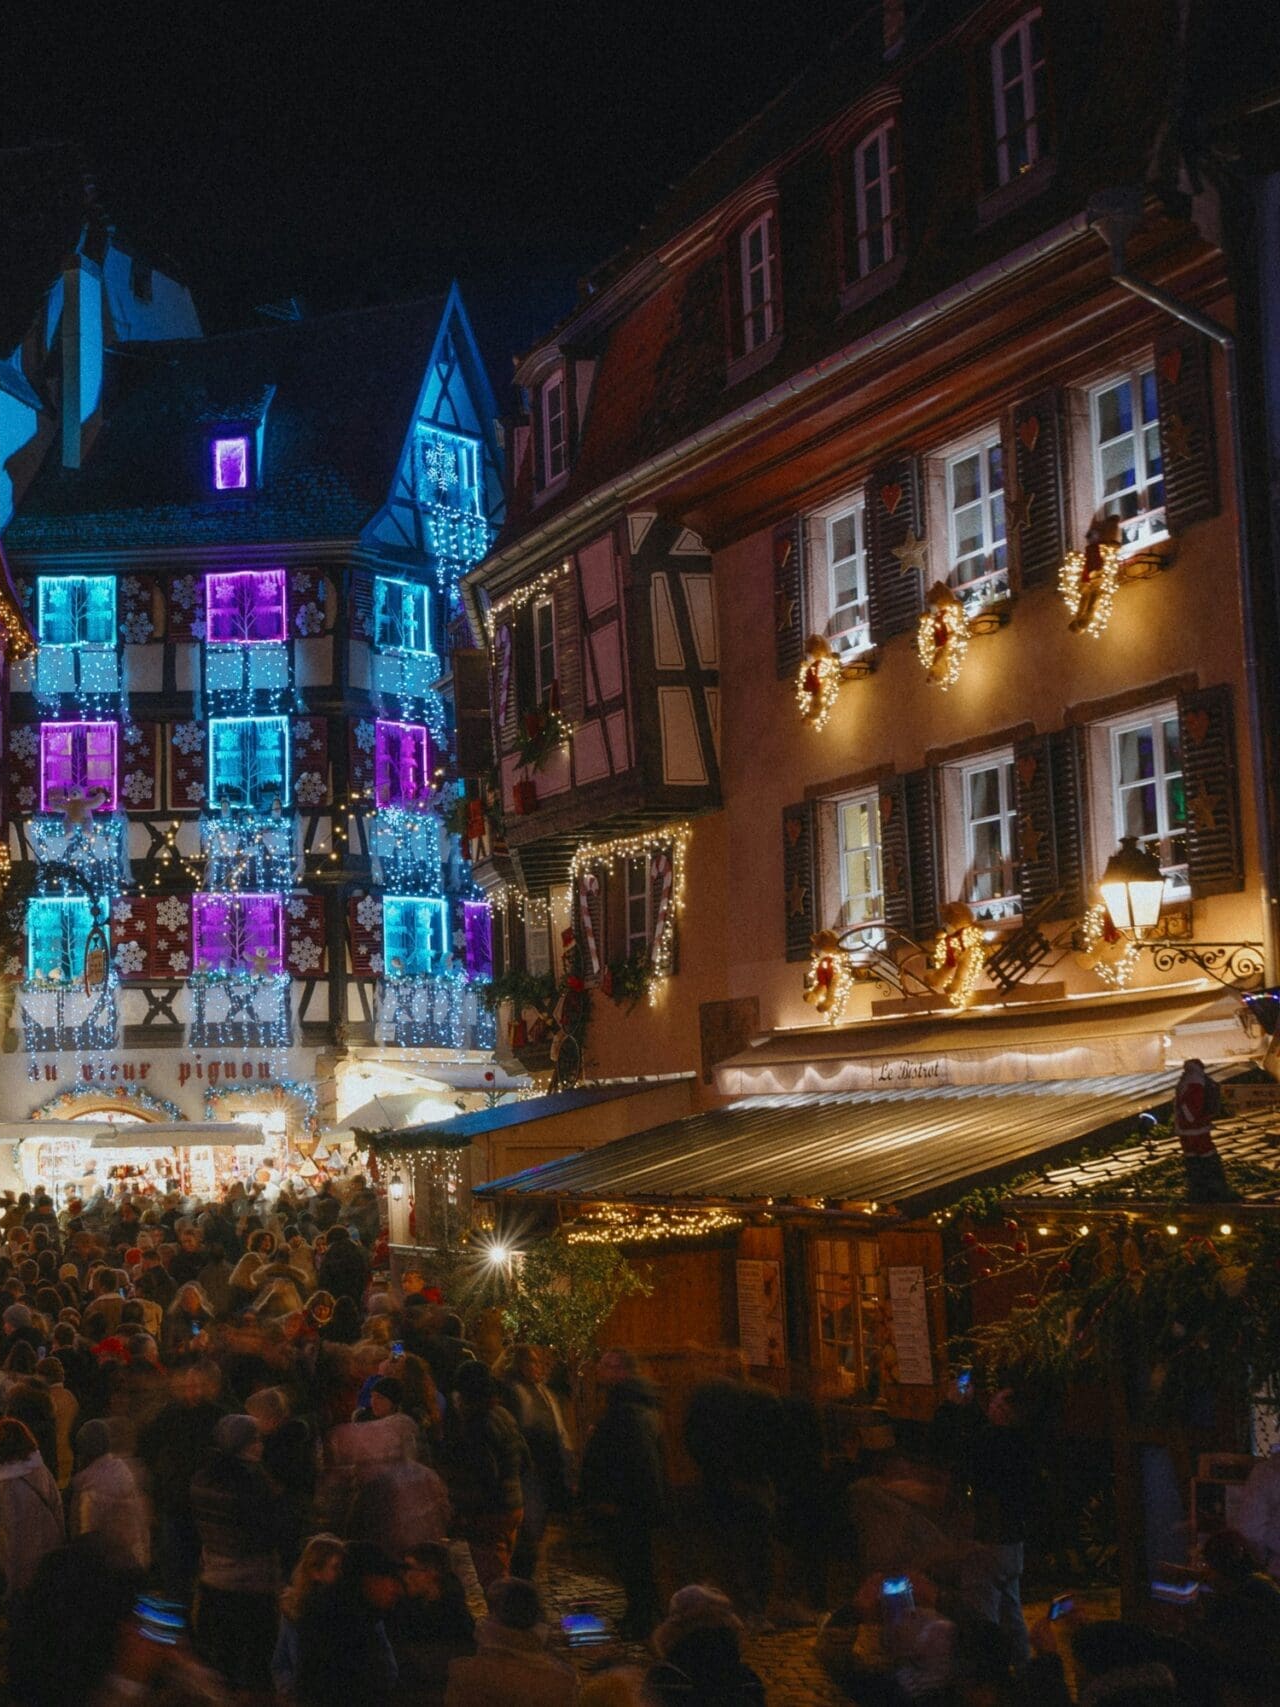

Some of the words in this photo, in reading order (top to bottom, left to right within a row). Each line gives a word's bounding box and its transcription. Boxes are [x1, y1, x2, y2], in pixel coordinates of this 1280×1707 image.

[178, 1054, 271, 1087] pignon
[878, 1061, 893, 1082] Le
[897, 1059, 939, 1080] Bistrot
